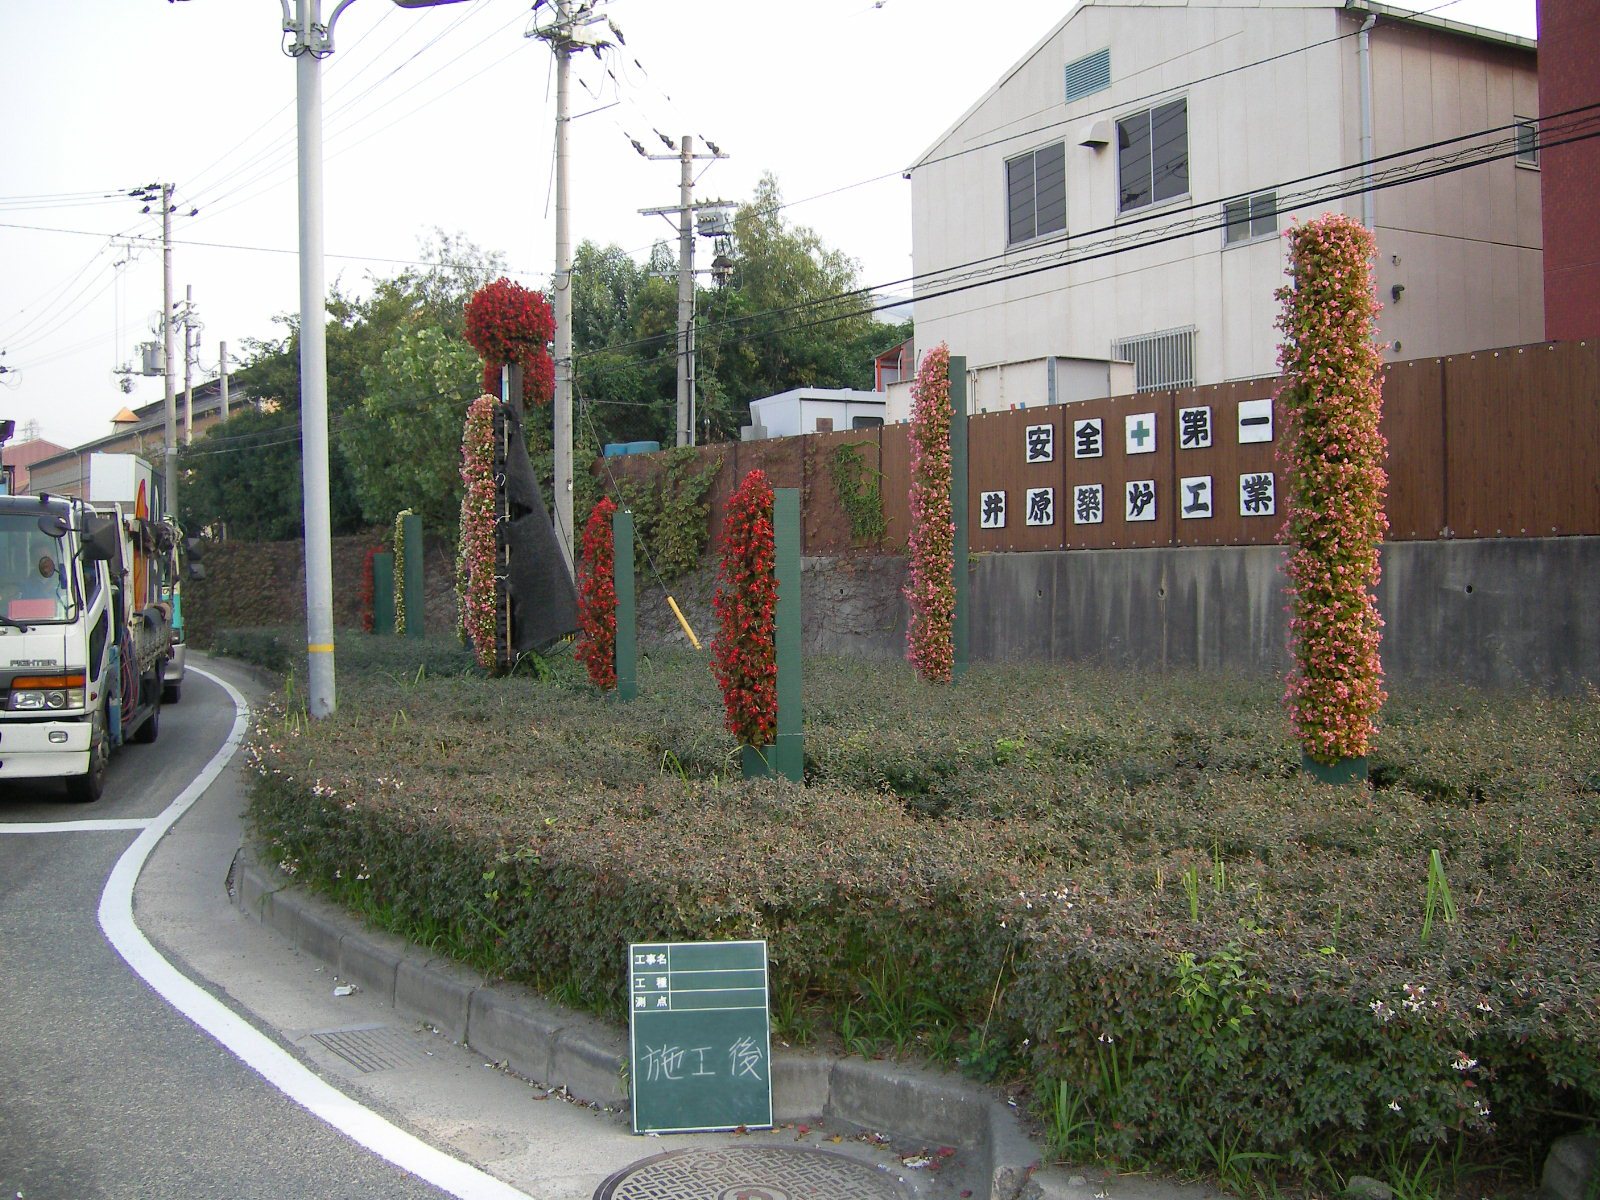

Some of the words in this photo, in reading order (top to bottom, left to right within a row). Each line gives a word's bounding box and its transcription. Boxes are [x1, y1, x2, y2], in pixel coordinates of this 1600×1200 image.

[983, 474, 1272, 526] 井原築炉工業
[634, 953, 667, 966] 工事名
[641, 1036, 763, 1081] 施工後
